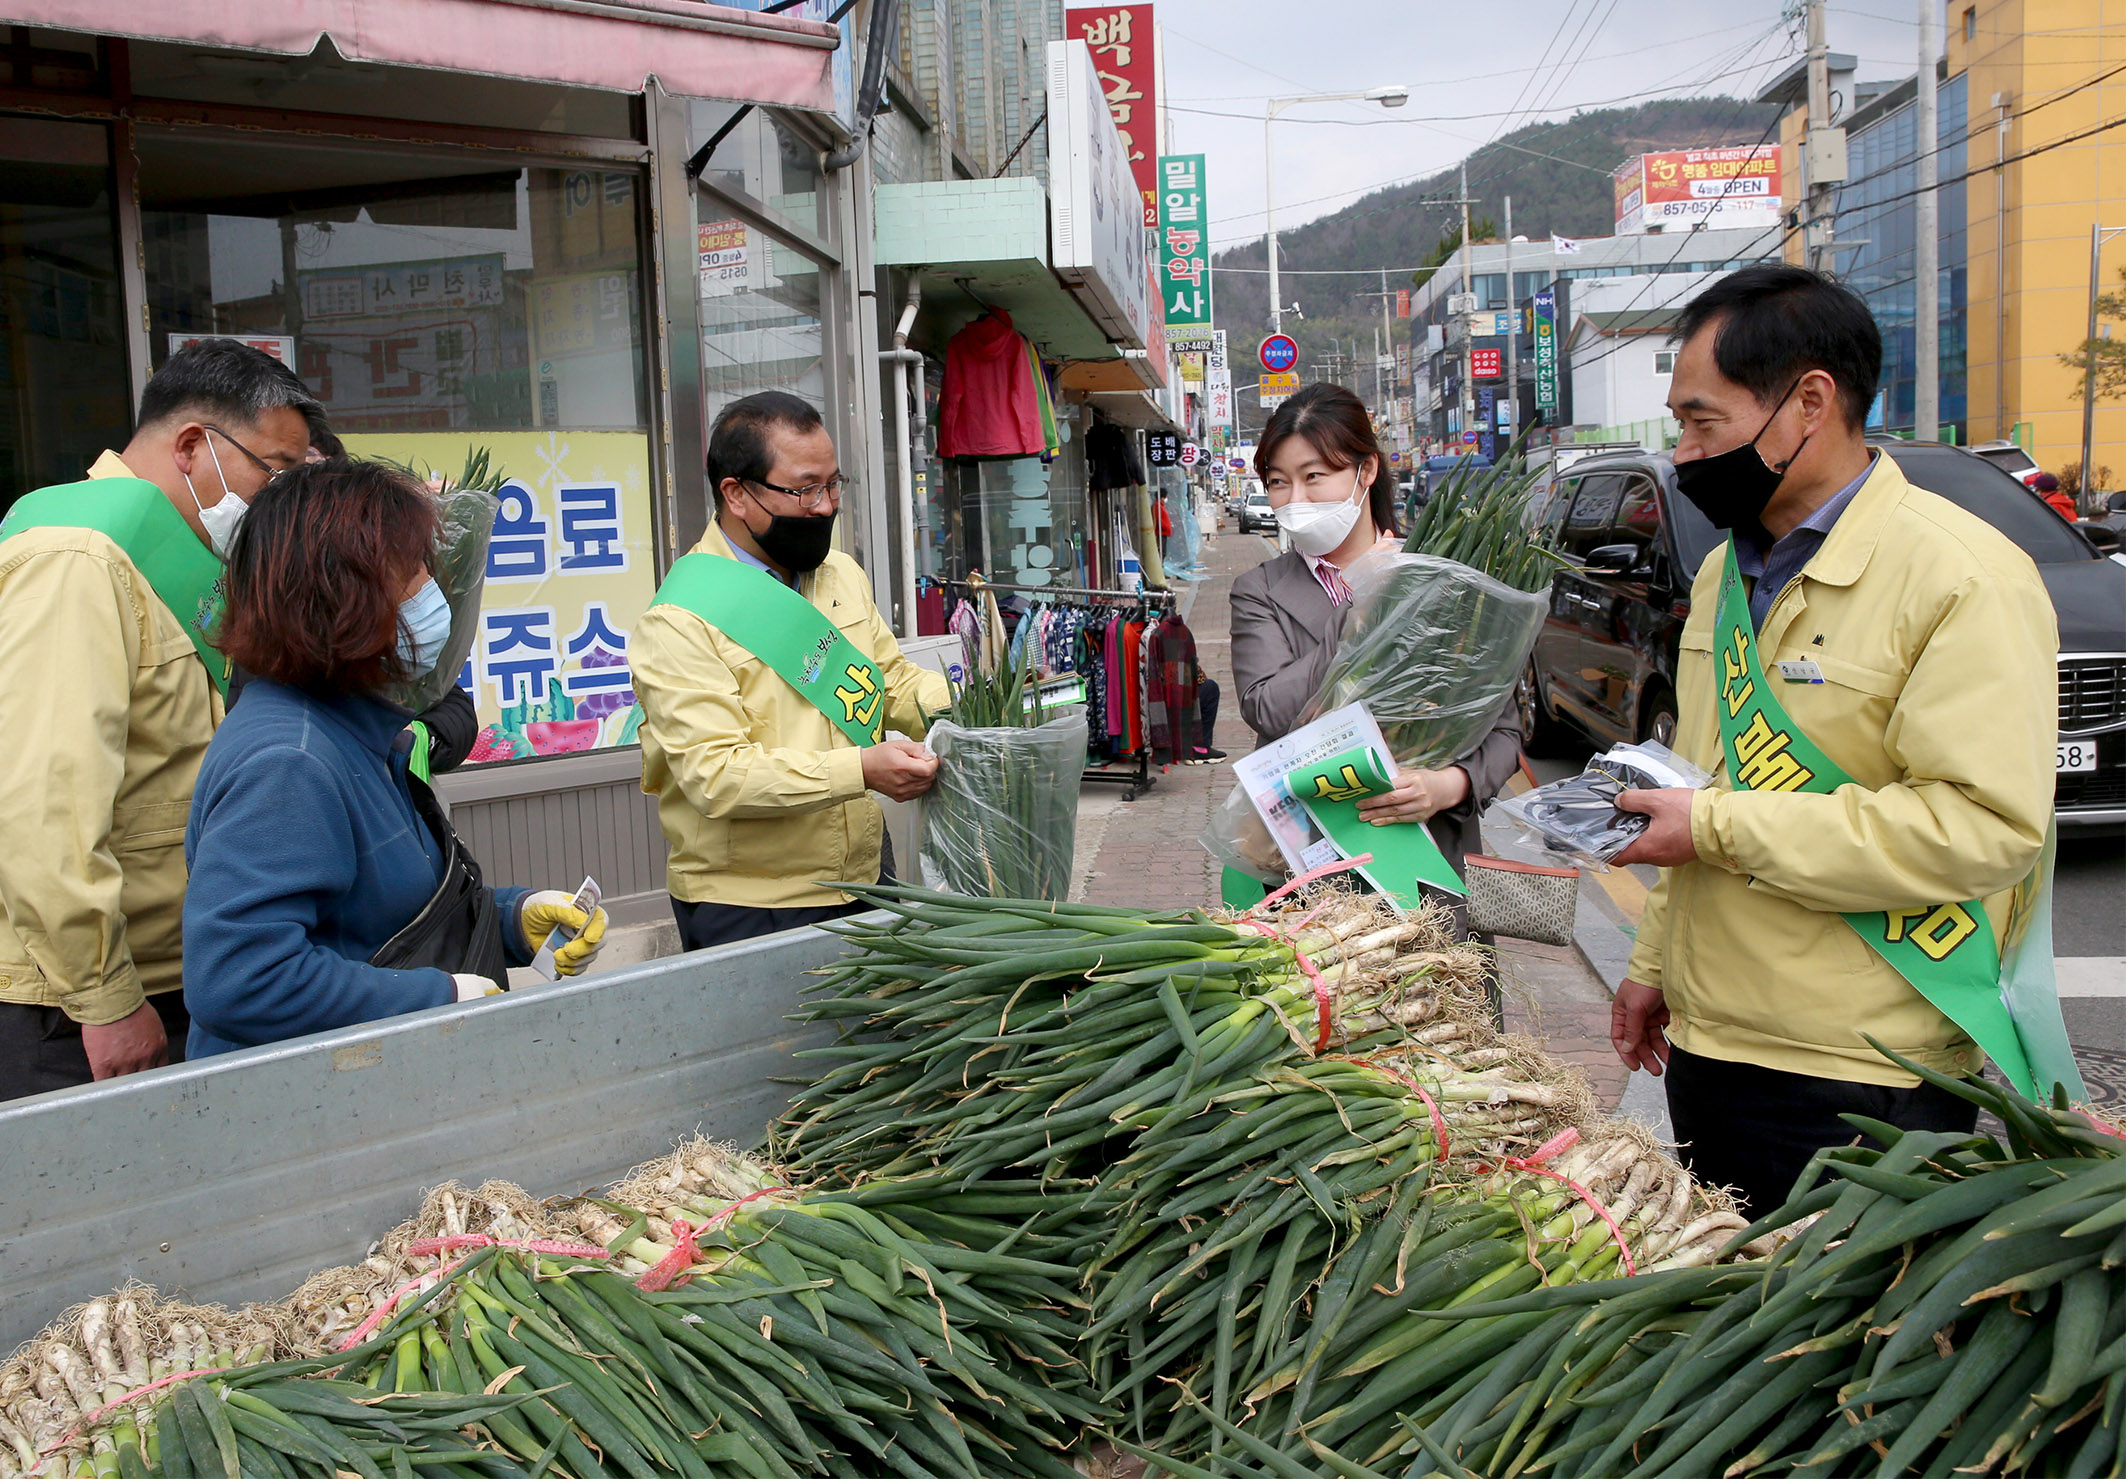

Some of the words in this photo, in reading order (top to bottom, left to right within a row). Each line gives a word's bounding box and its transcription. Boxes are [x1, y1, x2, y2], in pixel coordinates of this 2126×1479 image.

[1682, 162, 1708, 179] 명품
[1710, 159, 1777, 177] 임대아파트
[1724, 180, 1762, 195] OPEN
[1664, 201, 1723, 216] 857-0515
[1165, 161, 1205, 319] 밀알농약사
[1536, 297, 1553, 307] NH
[1175, 341, 1211, 351] 857-4492
[1474, 368, 1497, 376] daiso
[1150, 436, 1176, 448] 도배
[1150, 448, 1177, 462] 장판
[817, 629, 838, 658] 보성
[461, 606, 633, 703] 쥬스
